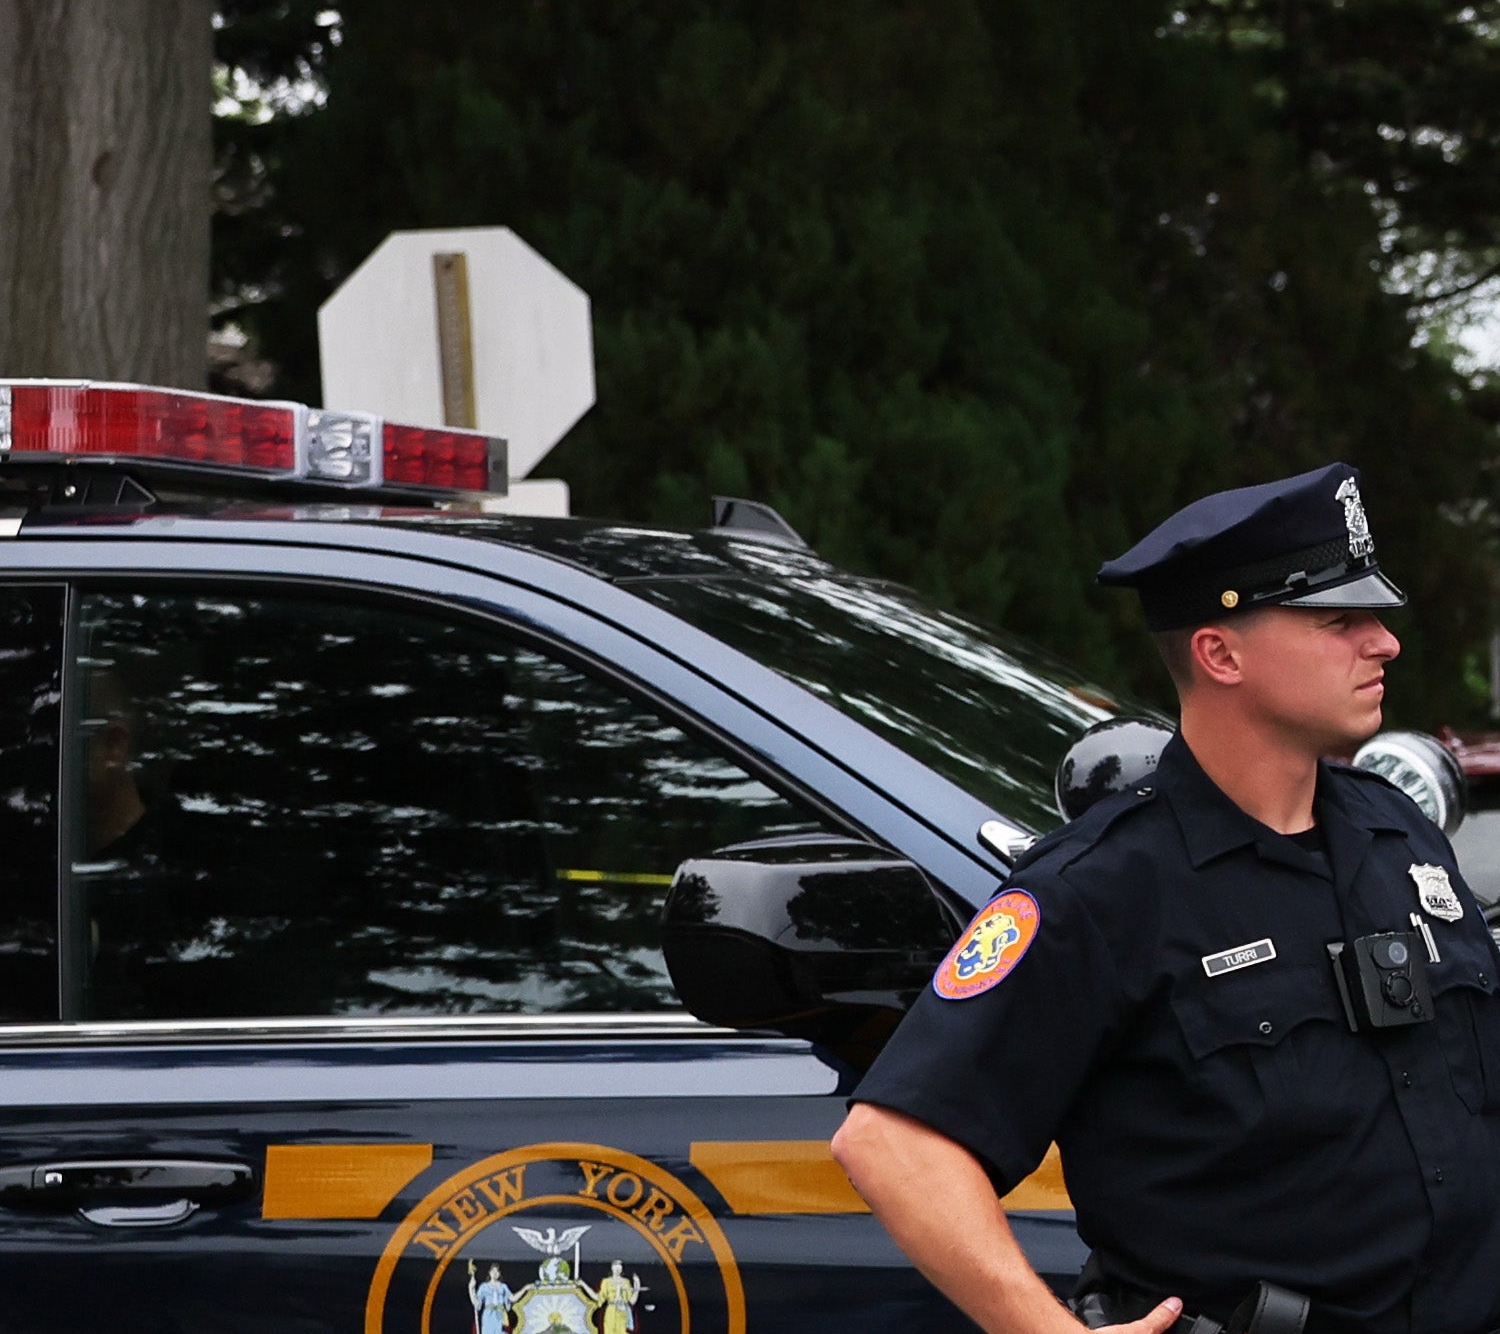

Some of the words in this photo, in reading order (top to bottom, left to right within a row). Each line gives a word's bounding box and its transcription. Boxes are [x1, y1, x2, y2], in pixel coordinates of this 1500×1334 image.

[1222, 948, 1258, 968] TURRI
[412, 1165, 527, 1258] NEW
[578, 1161, 704, 1262] YORK
